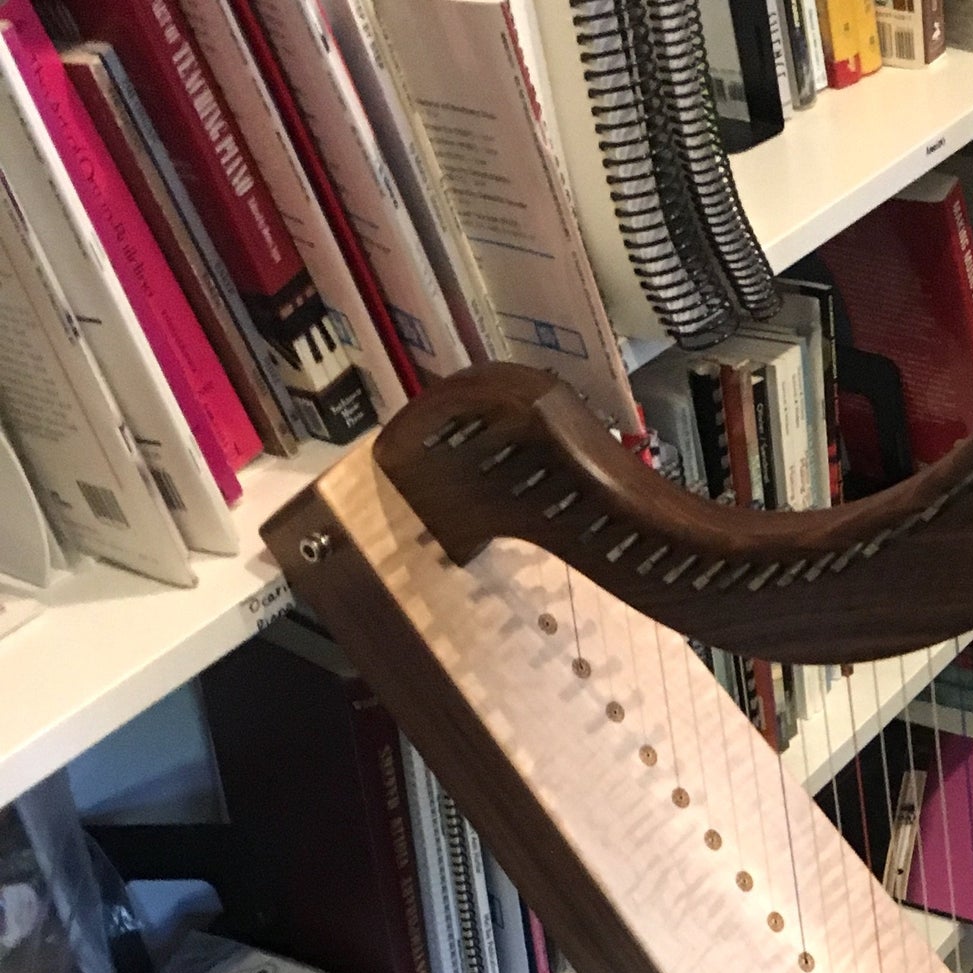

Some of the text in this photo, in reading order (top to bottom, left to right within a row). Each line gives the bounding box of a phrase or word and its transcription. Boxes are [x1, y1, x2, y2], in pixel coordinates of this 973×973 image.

[172, 41, 229, 142] TEACHING
[215, 133, 254, 197] PIANO
[952, 199, 970, 251] MAKING
